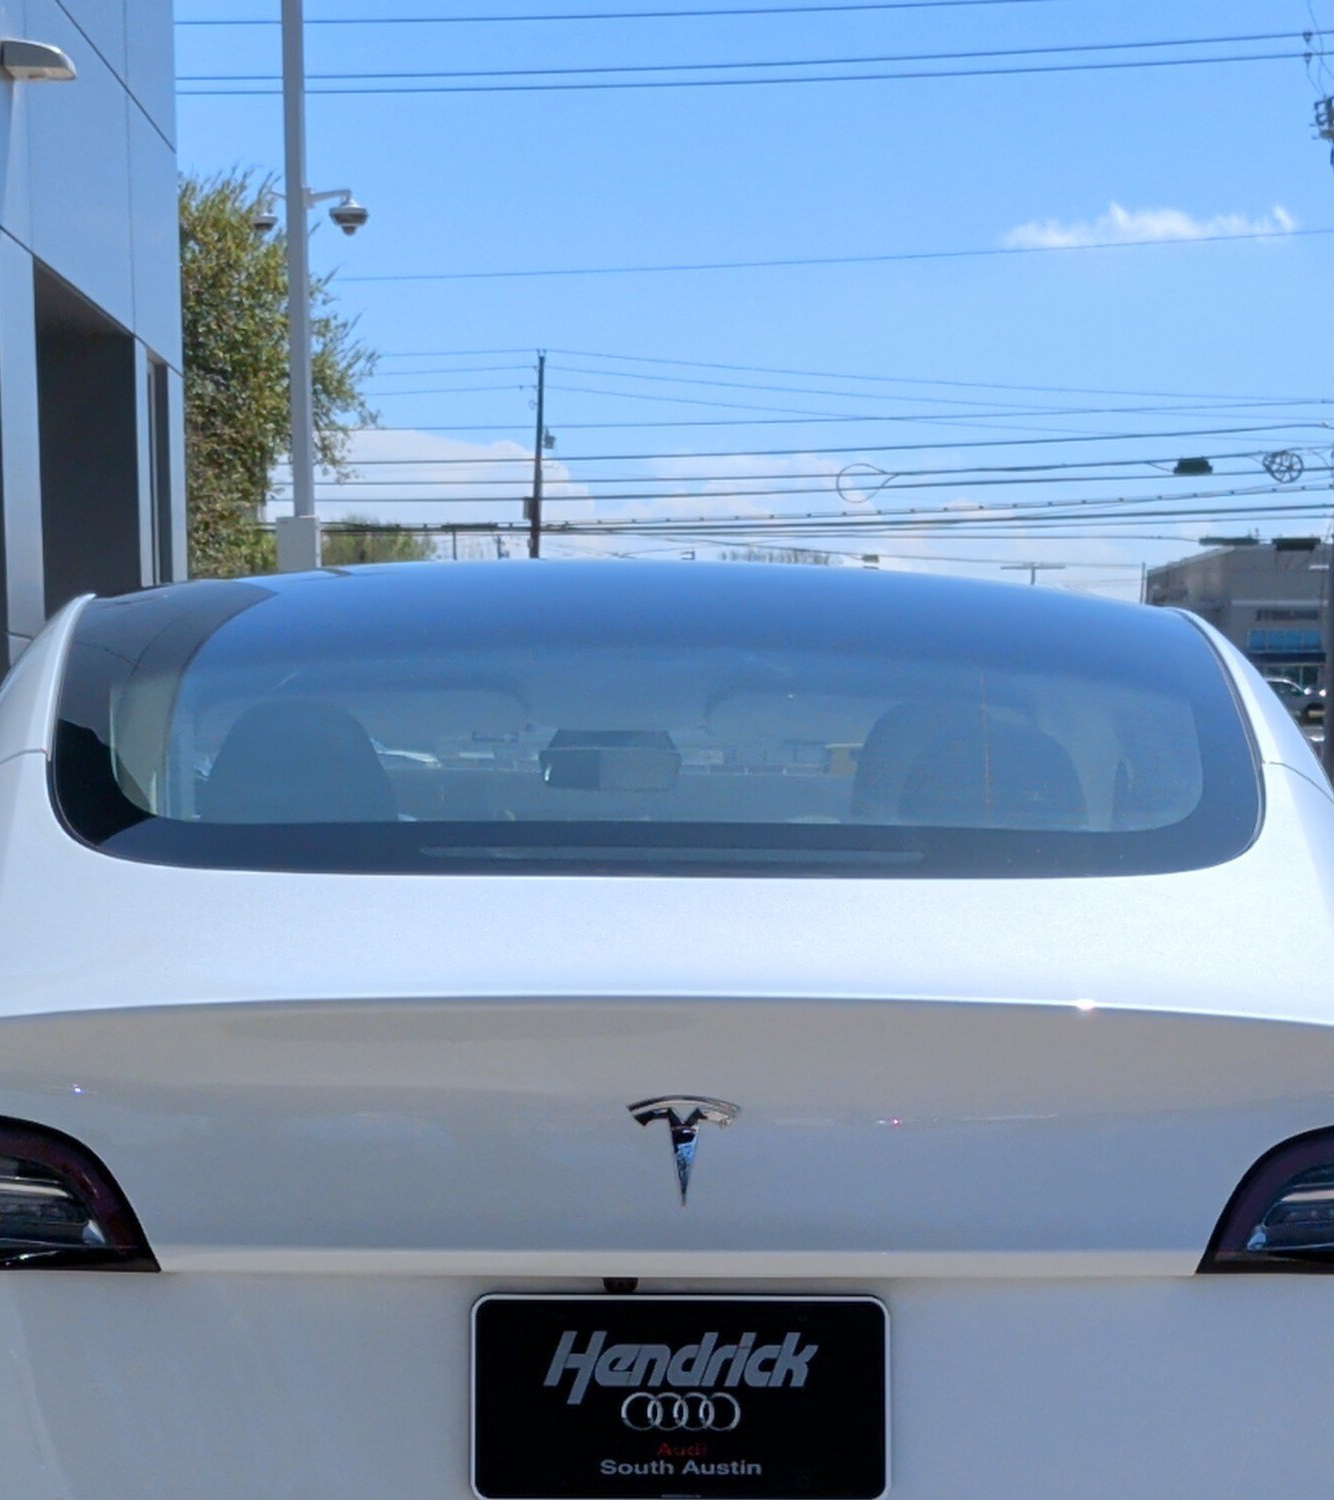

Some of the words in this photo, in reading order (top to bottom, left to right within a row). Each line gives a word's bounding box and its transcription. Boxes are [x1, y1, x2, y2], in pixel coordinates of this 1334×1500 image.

[543, 1331, 818, 1404] Hendrick
[658, 1443, 708, 1455] Audi
[600, 1459, 674, 1475] South
[682, 1459, 762, 1475] Austin
